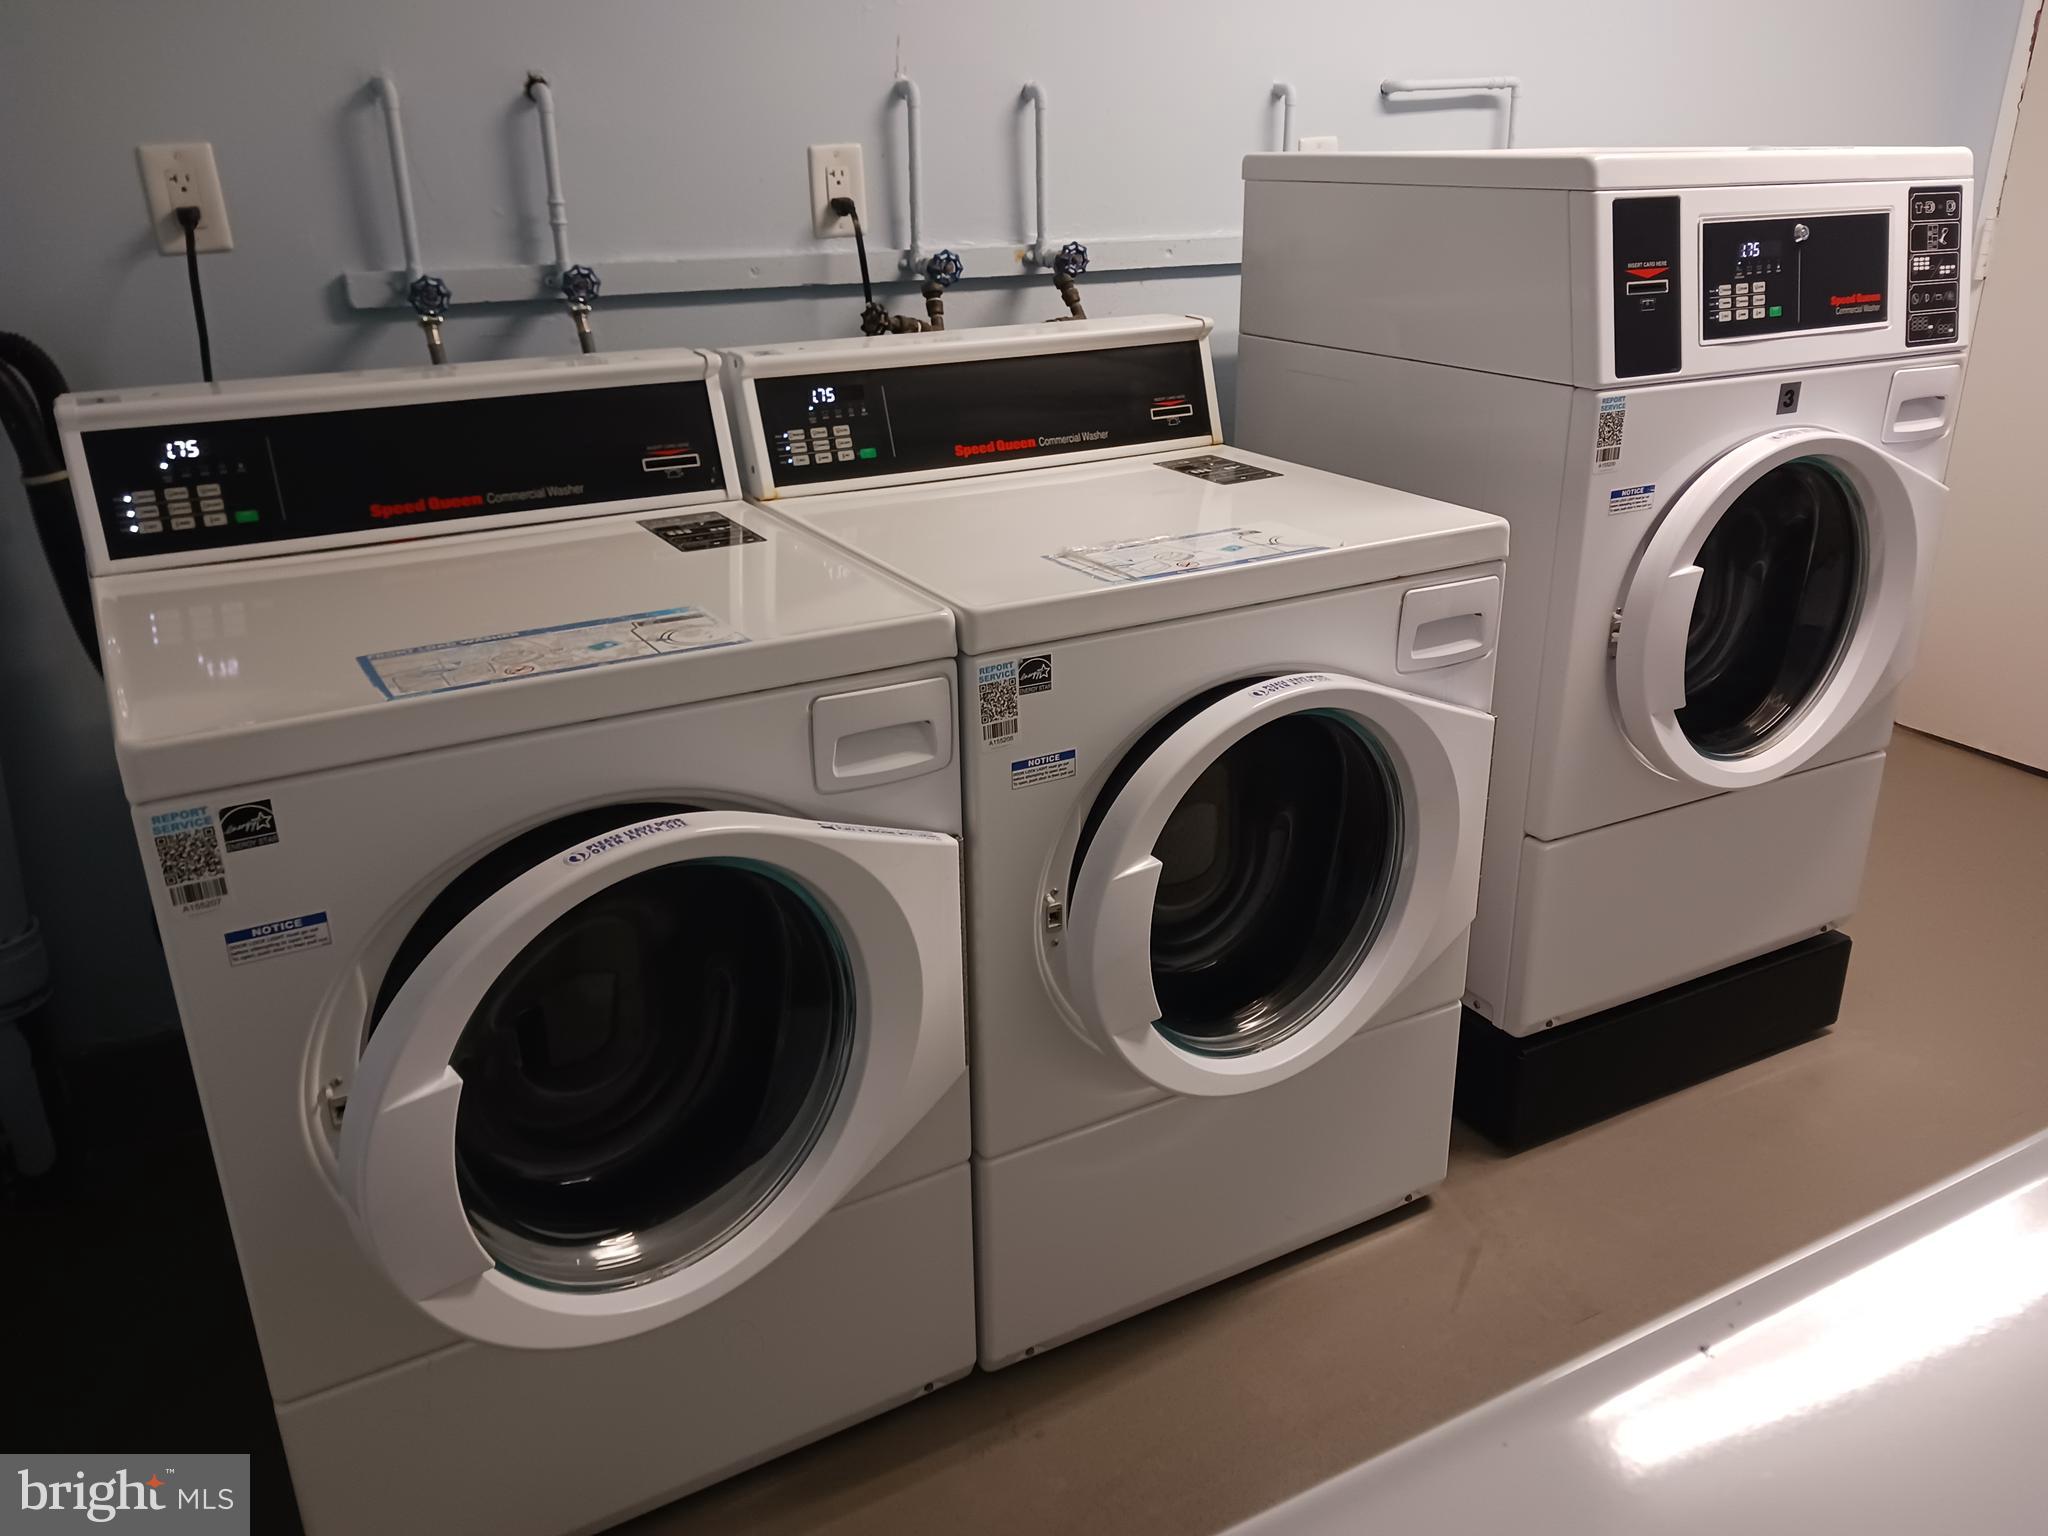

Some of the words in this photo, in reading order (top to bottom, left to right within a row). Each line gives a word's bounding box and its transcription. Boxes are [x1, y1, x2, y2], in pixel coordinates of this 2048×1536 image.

[1783, 389, 1795, 408] 3
[955, 441, 995, 457] Speed
[996, 437, 1036, 452] Queen
[1038, 433, 1080, 447] Commercial
[1081, 430, 1108, 441] Washer
[1621, 487, 1644, 496] NOTICE
[369, 498, 426, 519] Speed
[428, 495, 484, 511] Queen
[486, 487, 545, 504] Commercial
[547, 484, 584, 498] Washer
[979, 661, 1014, 675] REPORT
[979, 669, 1016, 683] SERVICE
[1028, 754, 1060, 767] NOTICE
[151, 805, 208, 825] REPORT
[152, 815, 213, 836] SERVICE
[251, 919, 303, 937] NOTICE
